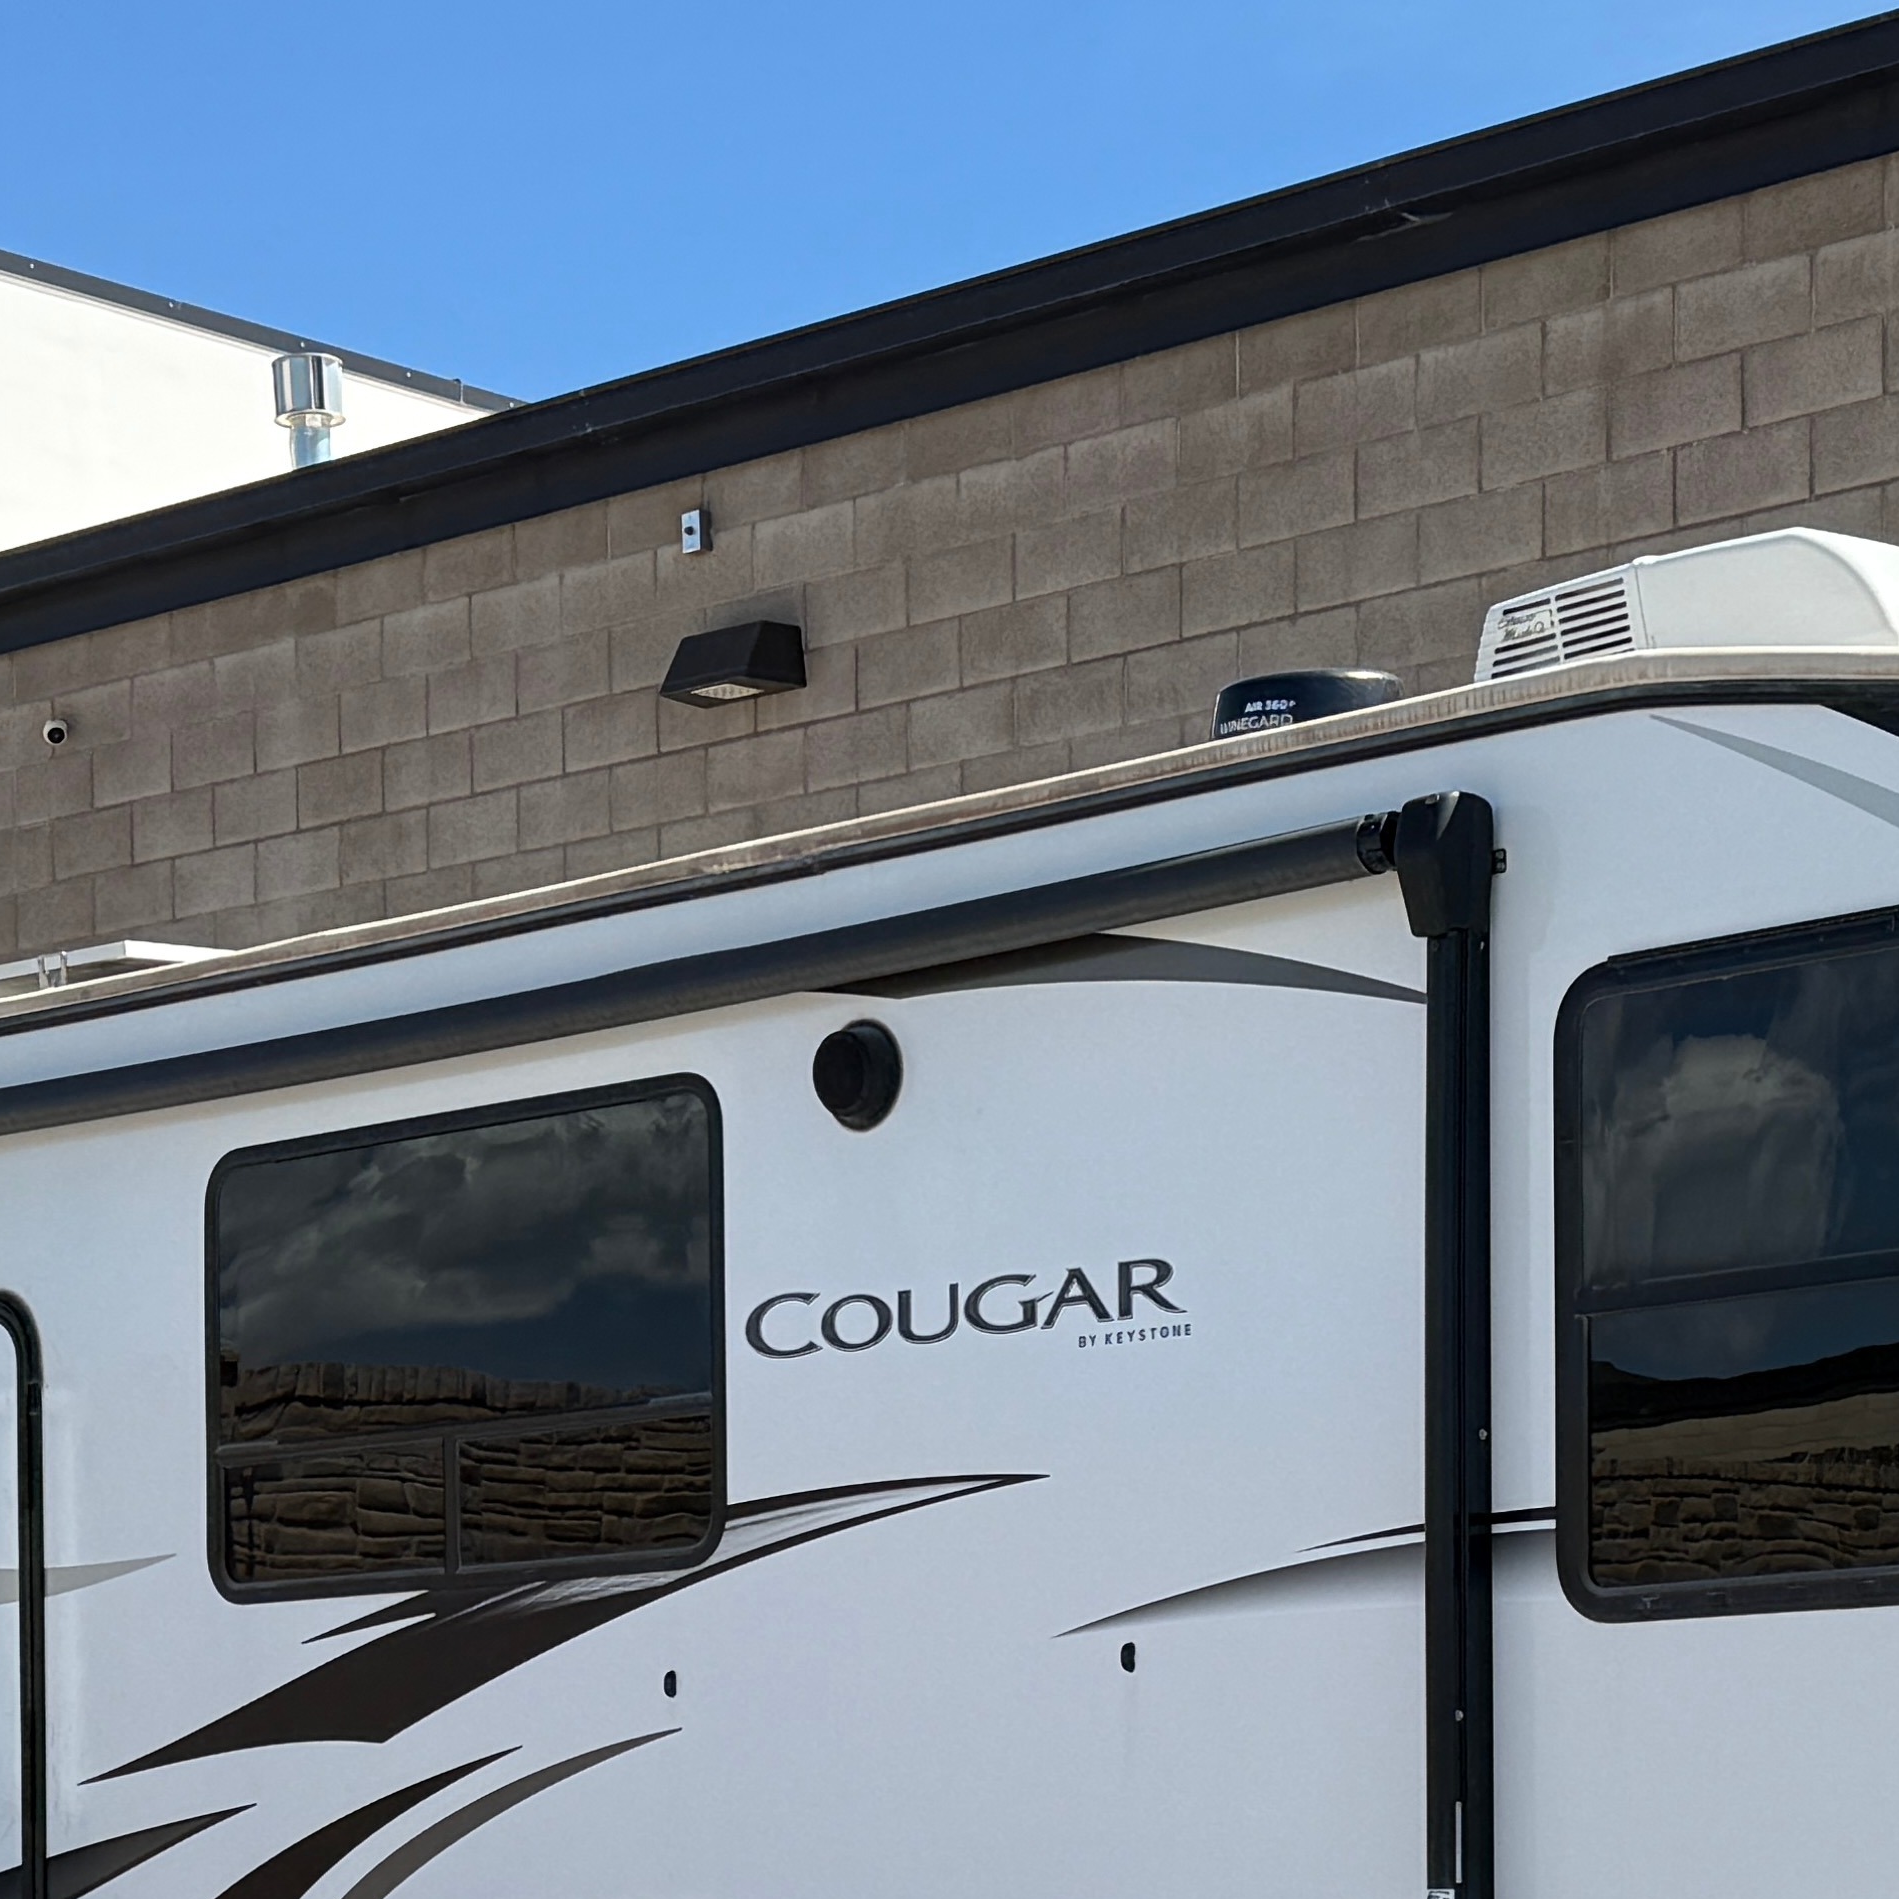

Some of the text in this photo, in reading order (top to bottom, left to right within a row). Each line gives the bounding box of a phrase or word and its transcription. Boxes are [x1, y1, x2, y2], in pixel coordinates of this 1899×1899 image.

[1244, 701, 1263, 713] AIR
[1220, 713, 1294, 735] WINEGARD
[744, 1257, 1189, 1360] COUGAR
[1078, 1323, 1192, 1349] BY KEYSTONE
